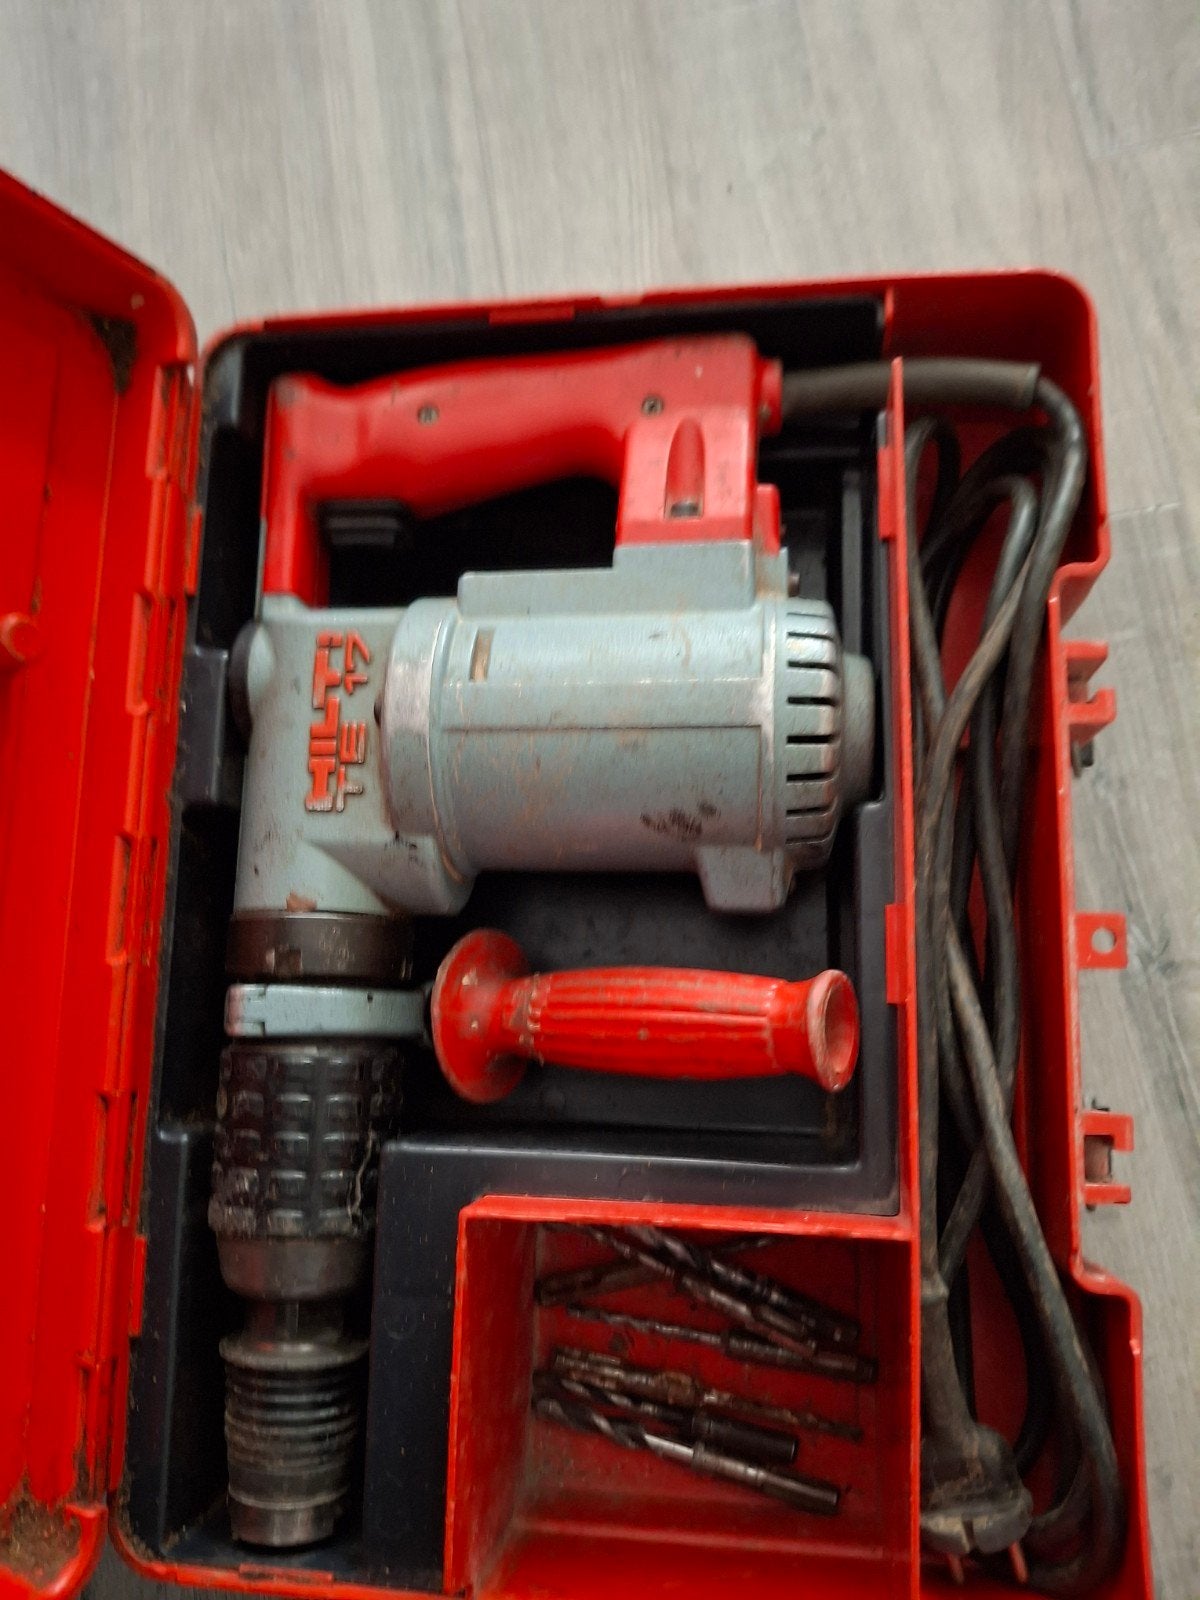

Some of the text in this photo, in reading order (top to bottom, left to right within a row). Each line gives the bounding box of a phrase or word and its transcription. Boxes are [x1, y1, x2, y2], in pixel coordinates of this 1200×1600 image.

[305, 632, 343, 812] HILTI
[336, 632, 370, 812] TE 17
